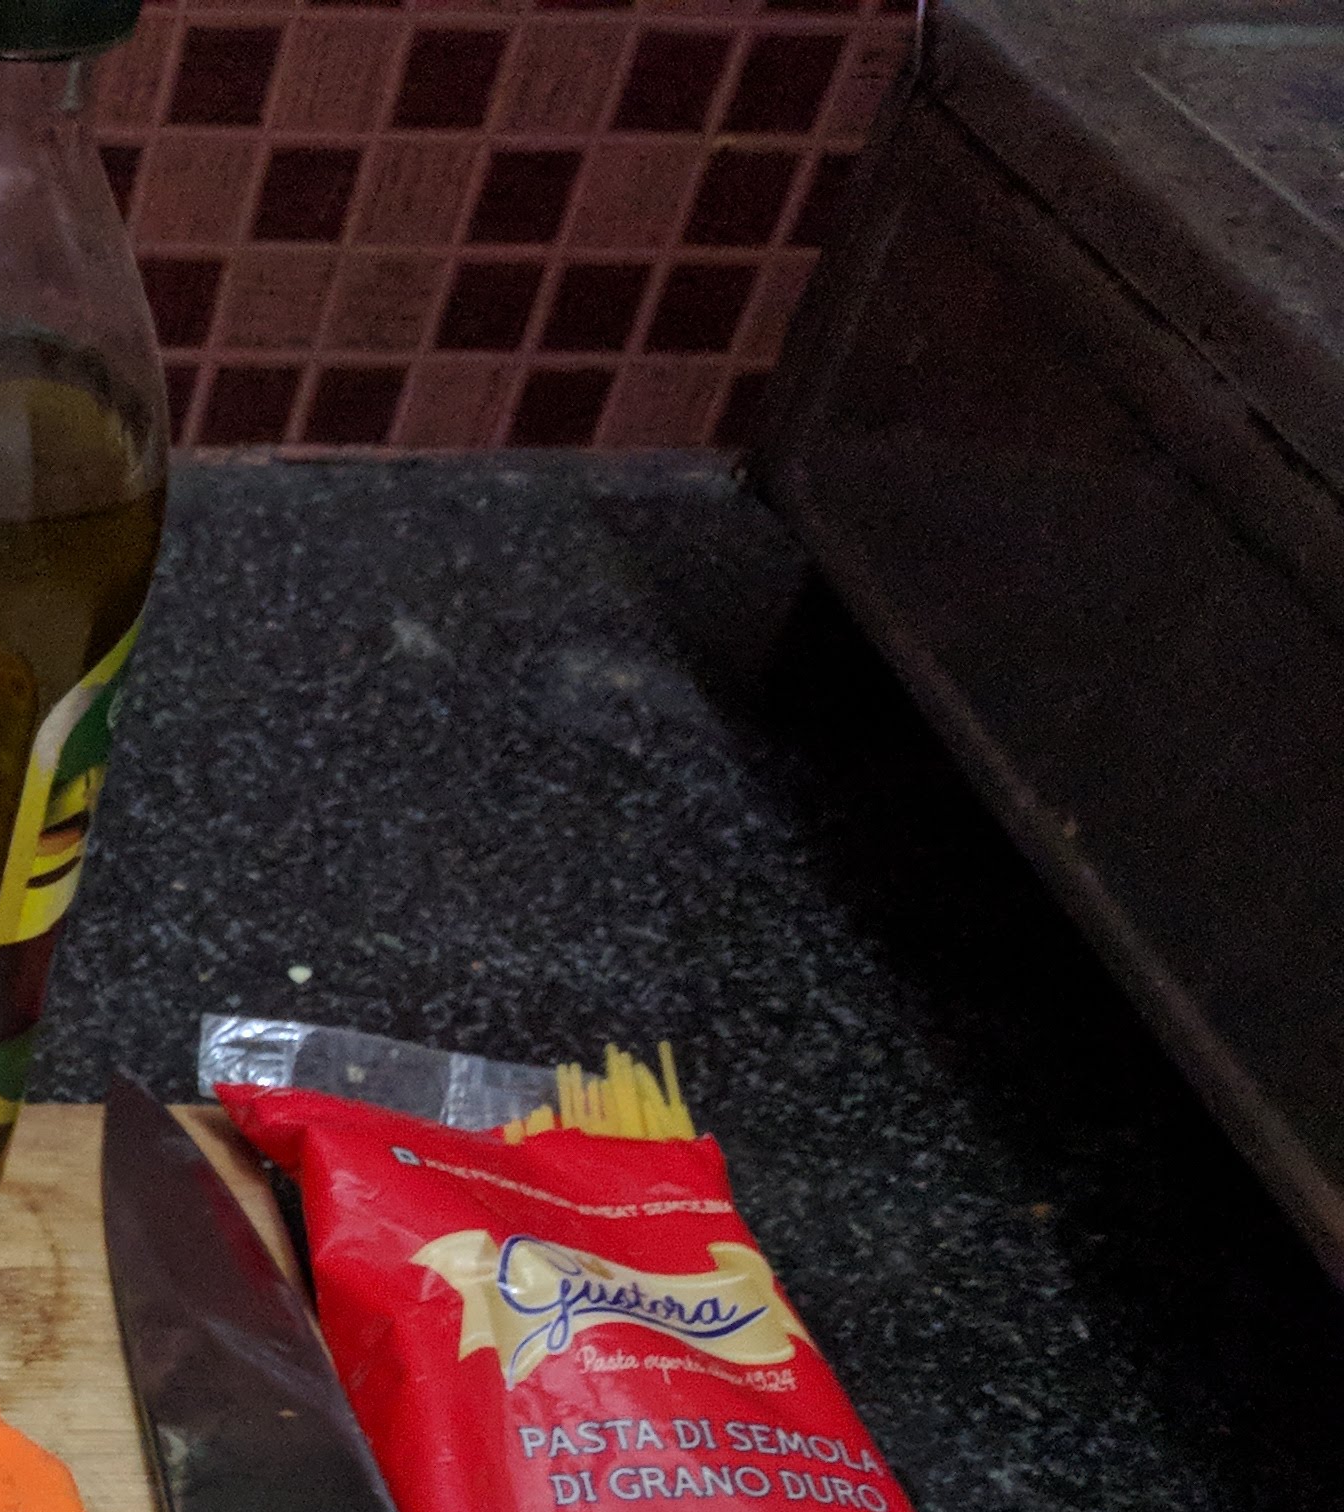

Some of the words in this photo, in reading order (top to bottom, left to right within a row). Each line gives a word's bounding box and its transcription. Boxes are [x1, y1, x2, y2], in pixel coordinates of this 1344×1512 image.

[498, 1235, 767, 1385] Gustora
[575, 1345, 640, 1376] Pasta
[518, 1418, 664, 1459] PASTA
[673, 1418, 716, 1451] DI
[725, 1422, 885, 1477] SEMOLA
[549, 1471, 598, 1506] DI
[608, 1465, 772, 1502] GRANO
